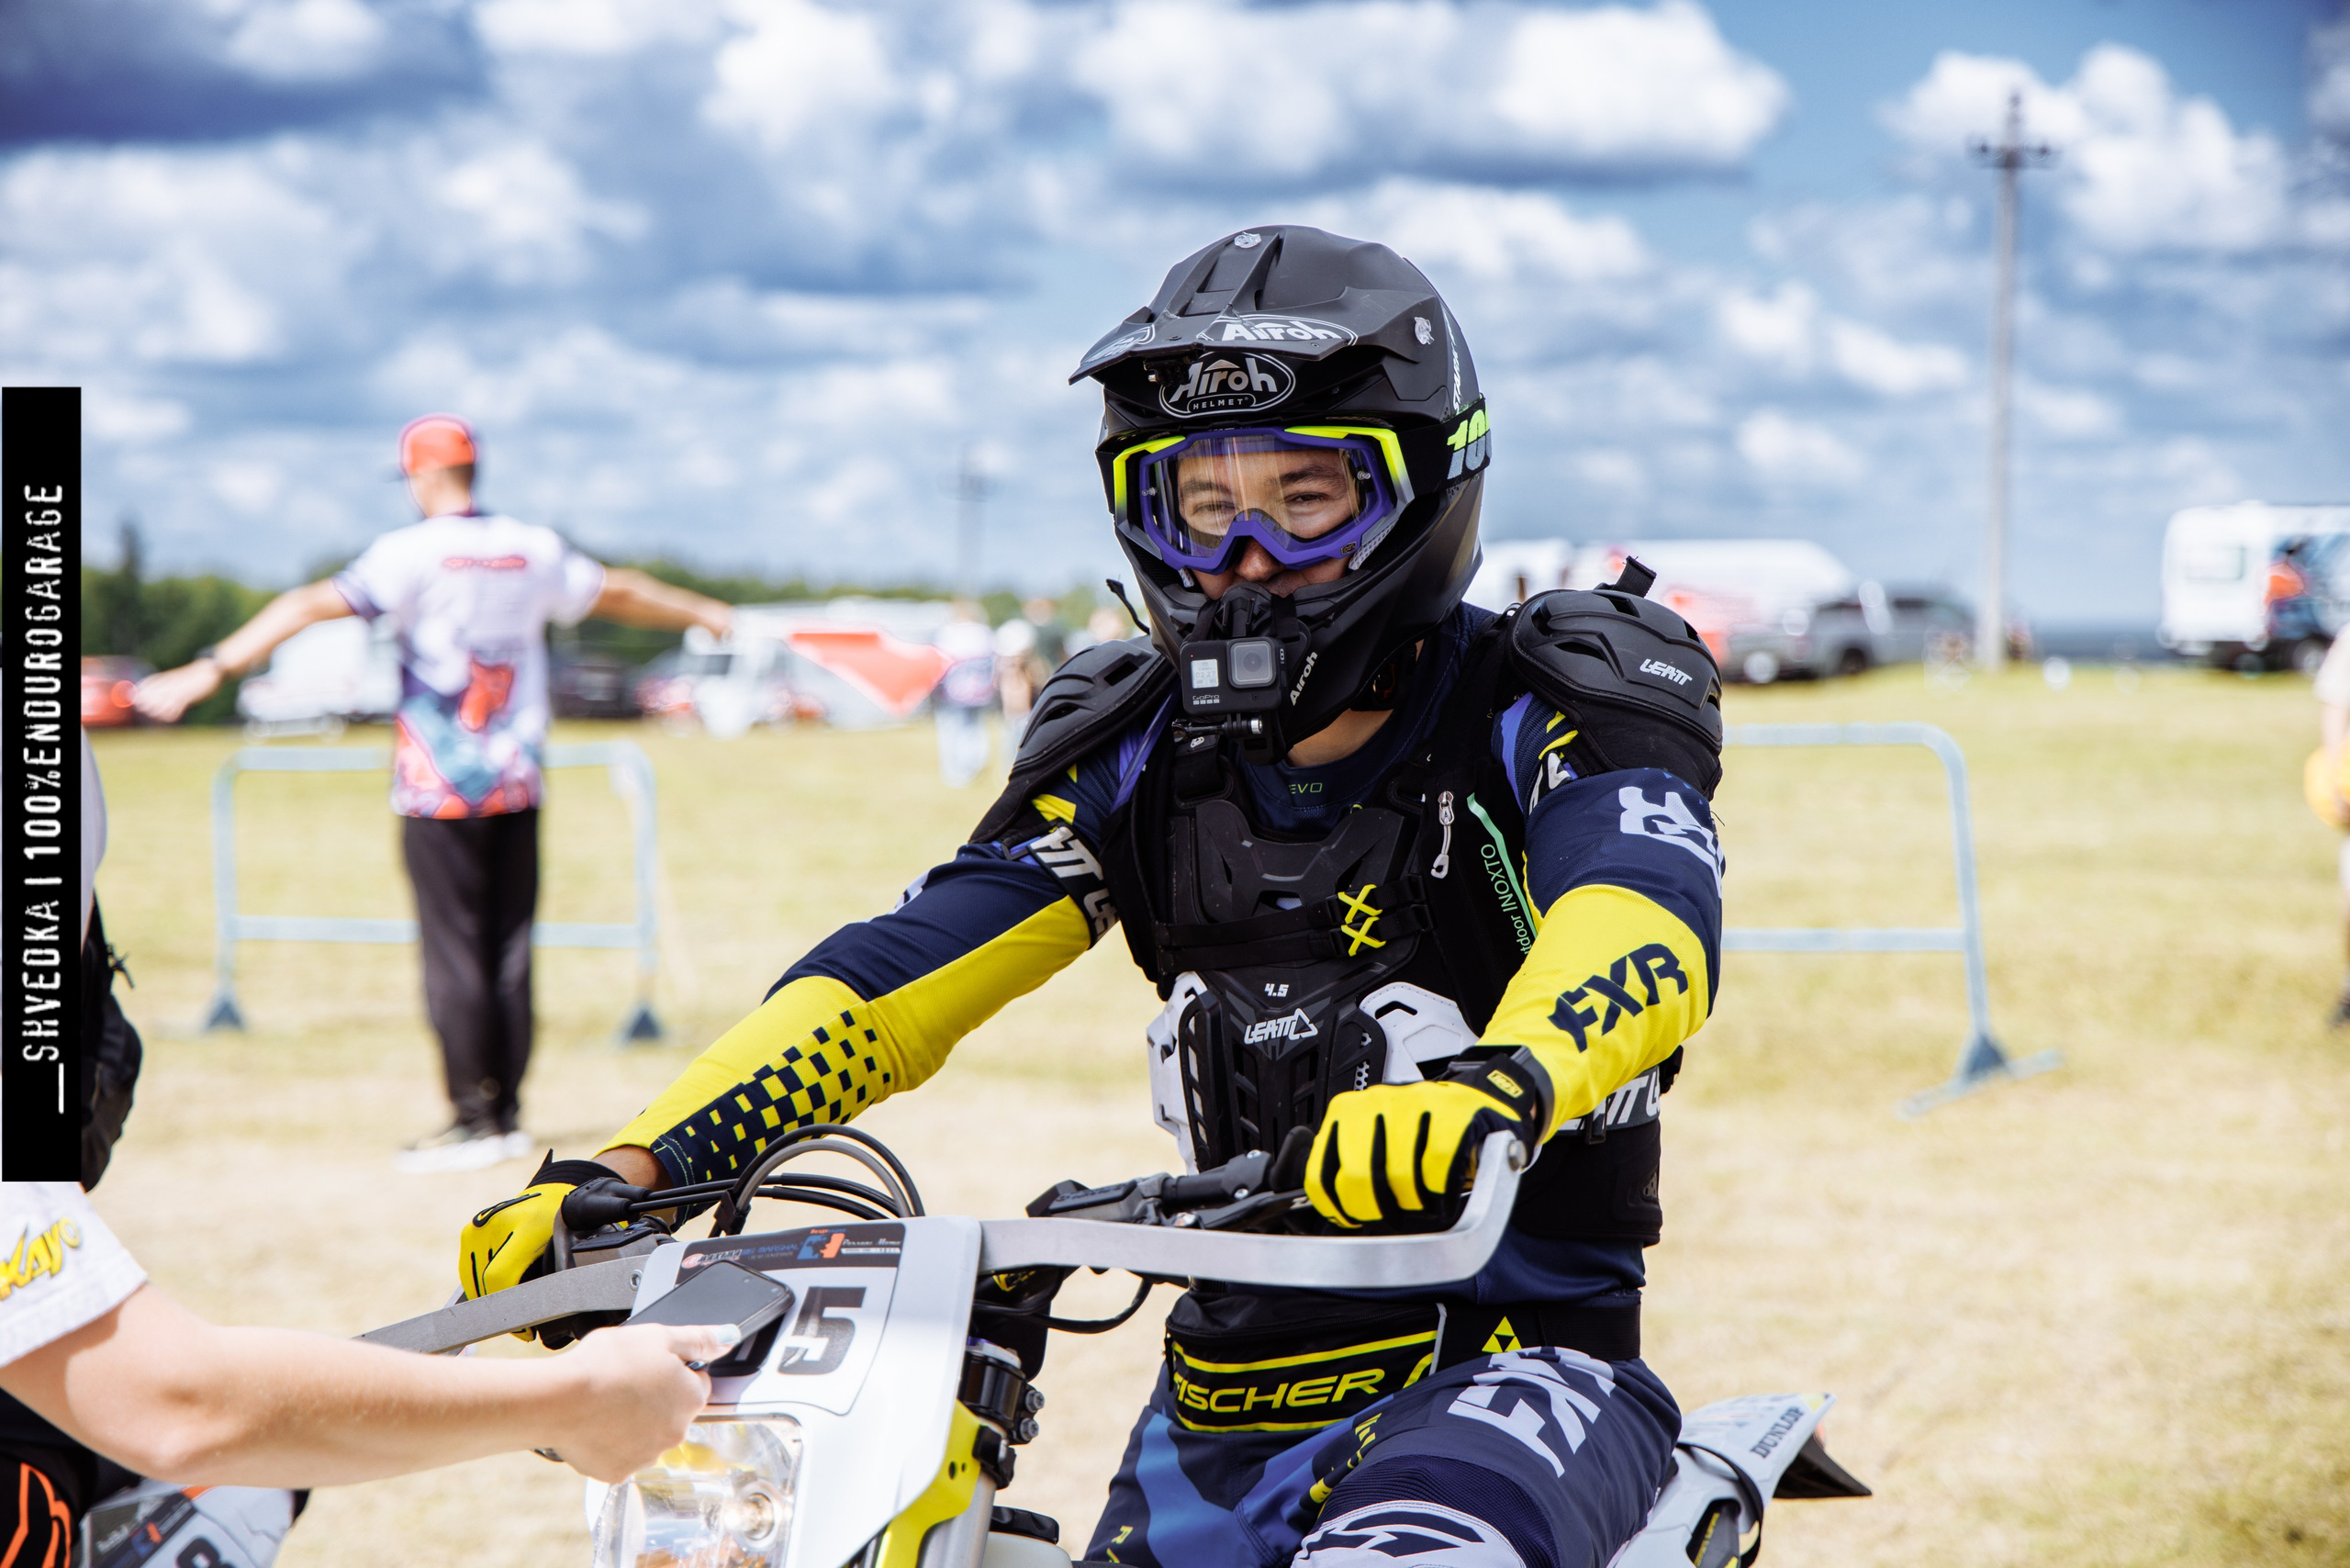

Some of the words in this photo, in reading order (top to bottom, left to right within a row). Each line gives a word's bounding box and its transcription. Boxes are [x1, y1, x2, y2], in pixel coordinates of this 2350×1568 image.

[1223, 320, 1343, 342] Airoh
[1168, 357, 1278, 404] Airoh
[1289, 650, 1319, 707] Airoh
[1639, 658, 1694, 686] LEATT
[1480, 843, 1519, 913] INOXTO
[1264, 982, 1290, 998] 4.5
[1547, 943, 1689, 1054] FXR
[1243, 1014, 1299, 1045] LEATT
[1749, 1404, 1805, 1459] DUNLOP
